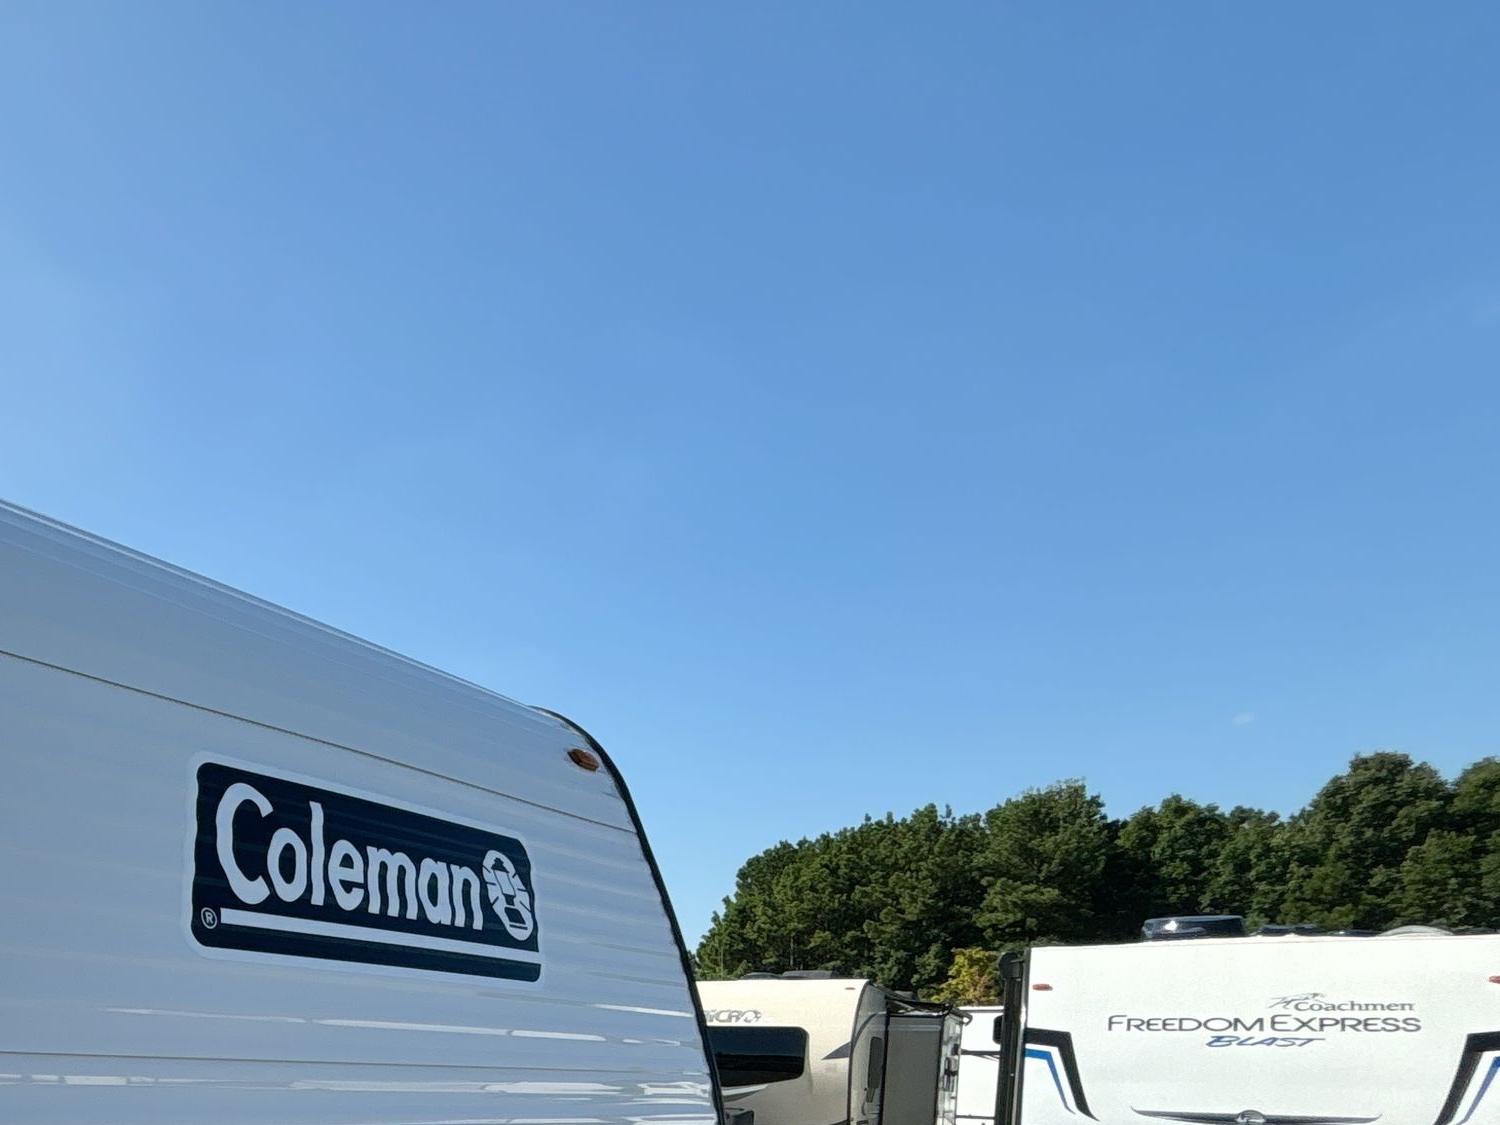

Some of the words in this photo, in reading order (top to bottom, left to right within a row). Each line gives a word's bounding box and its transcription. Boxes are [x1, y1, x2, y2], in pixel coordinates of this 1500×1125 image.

[216, 782, 484, 931] Coleman
[1293, 1001, 1415, 1012] Coachmen
[1108, 1014, 1265, 1032] FREEDOM
[1270, 1014, 1422, 1032] EXPRESS
[1205, 1035, 1326, 1048] BLAST
